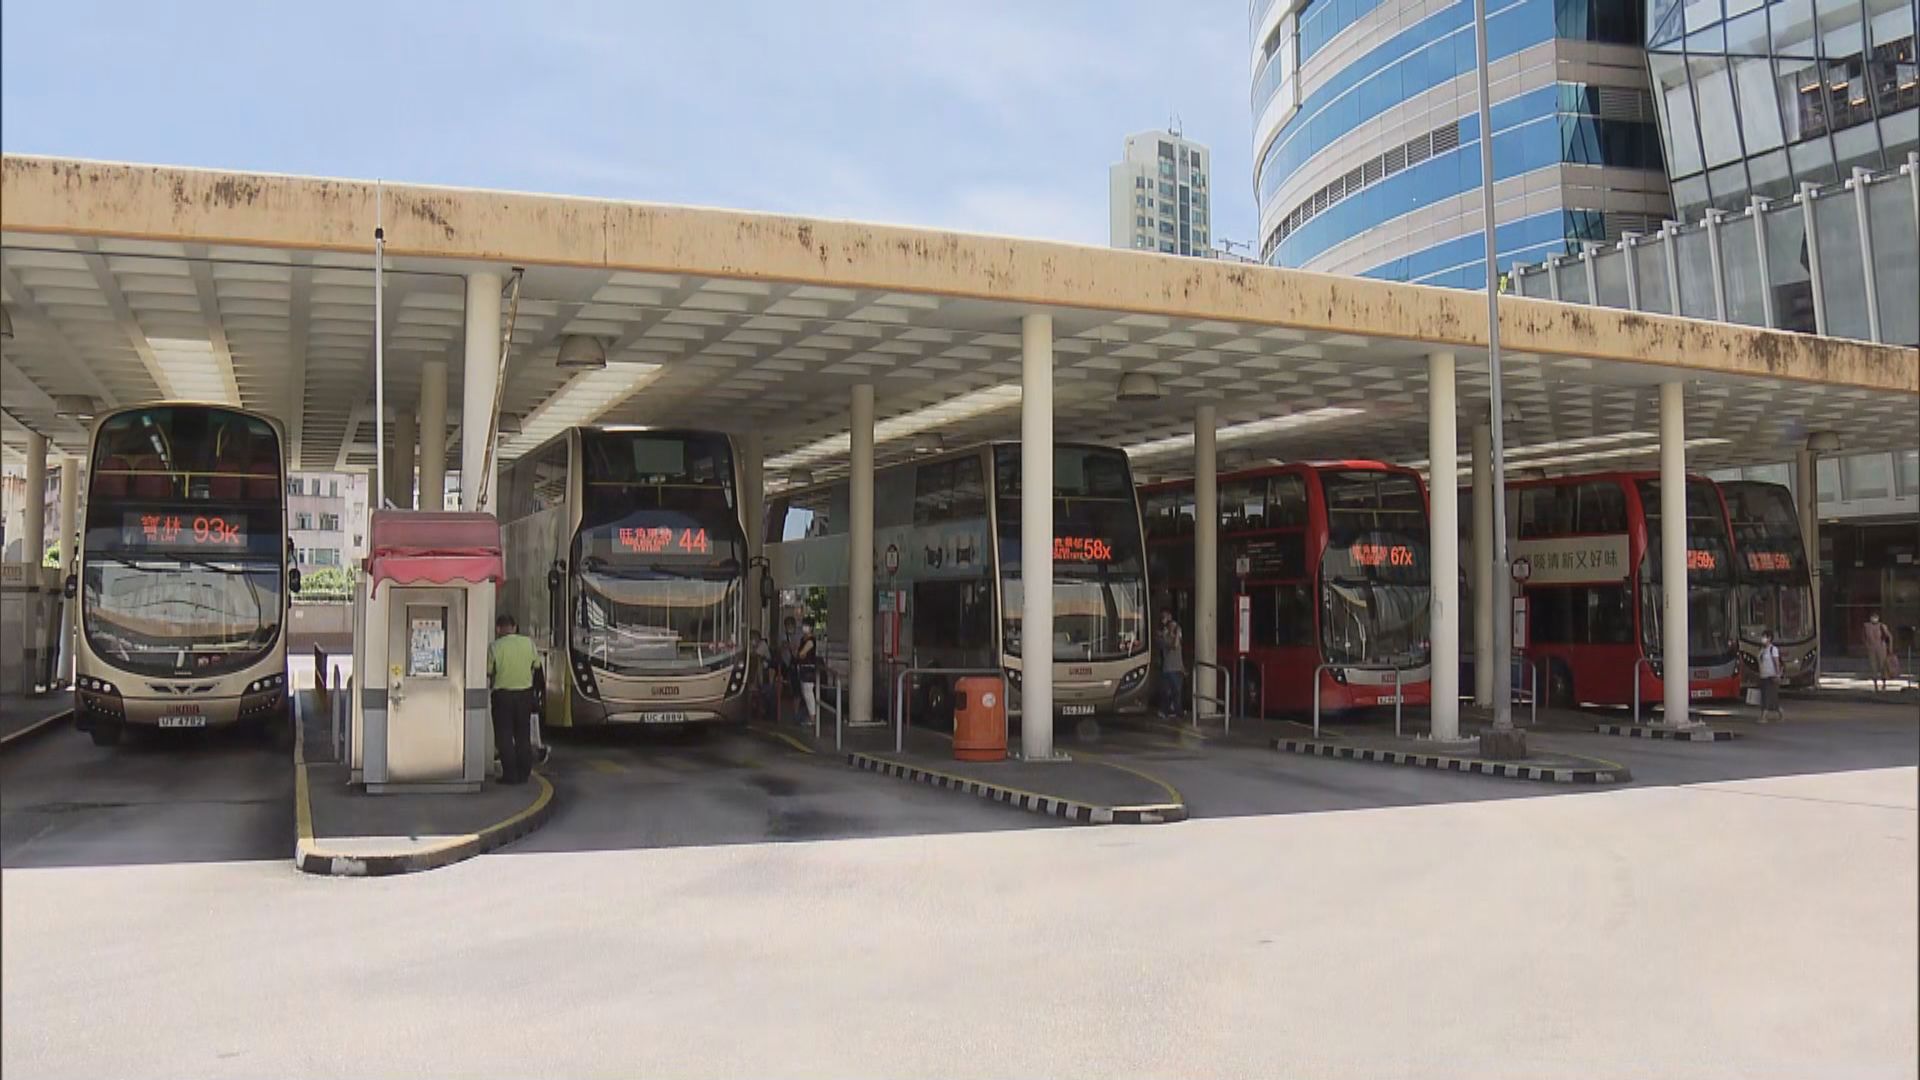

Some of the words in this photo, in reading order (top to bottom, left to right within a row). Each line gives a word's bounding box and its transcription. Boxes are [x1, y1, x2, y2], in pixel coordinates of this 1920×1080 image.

[141, 514, 182, 535] 寶林
[193, 516, 240, 544] 93K
[679, 527, 707, 553] 44
[1524, 550, 1617, 569] 啖清新又好味
